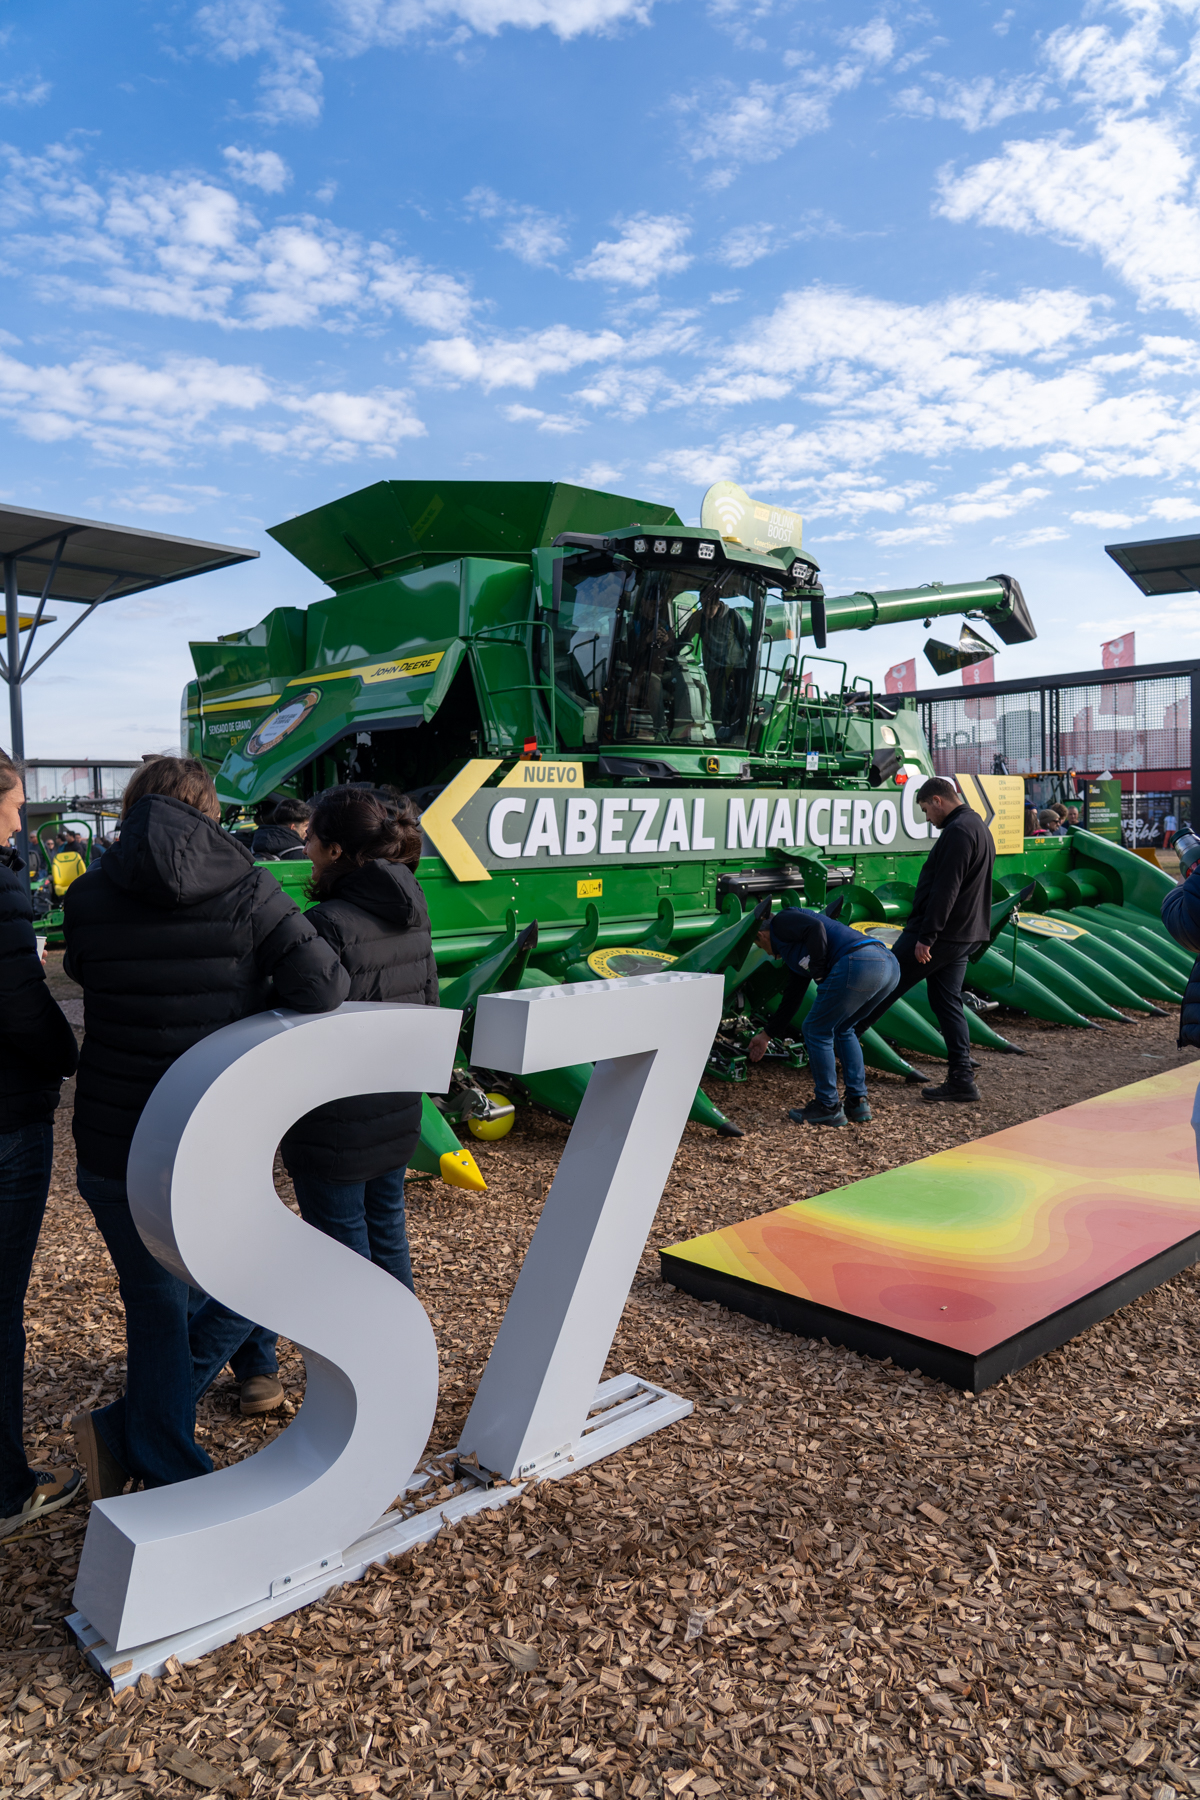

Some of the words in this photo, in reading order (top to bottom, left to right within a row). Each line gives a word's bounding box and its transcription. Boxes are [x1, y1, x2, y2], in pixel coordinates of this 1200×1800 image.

[768, 525, 792, 542] BOOST
[370, 665, 400, 678] JOHN
[399, 658, 435, 673] DEERE
[208, 723, 229, 735] SENSADO
[228, 721, 236, 732] DE
[234, 719, 252, 731] GRANO
[523, 765, 578, 784] NUEVO
[487, 796, 716, 860] CABEZAL
[726, 797, 898, 850] MAICERO
[73, 972, 725, 1652] S7
